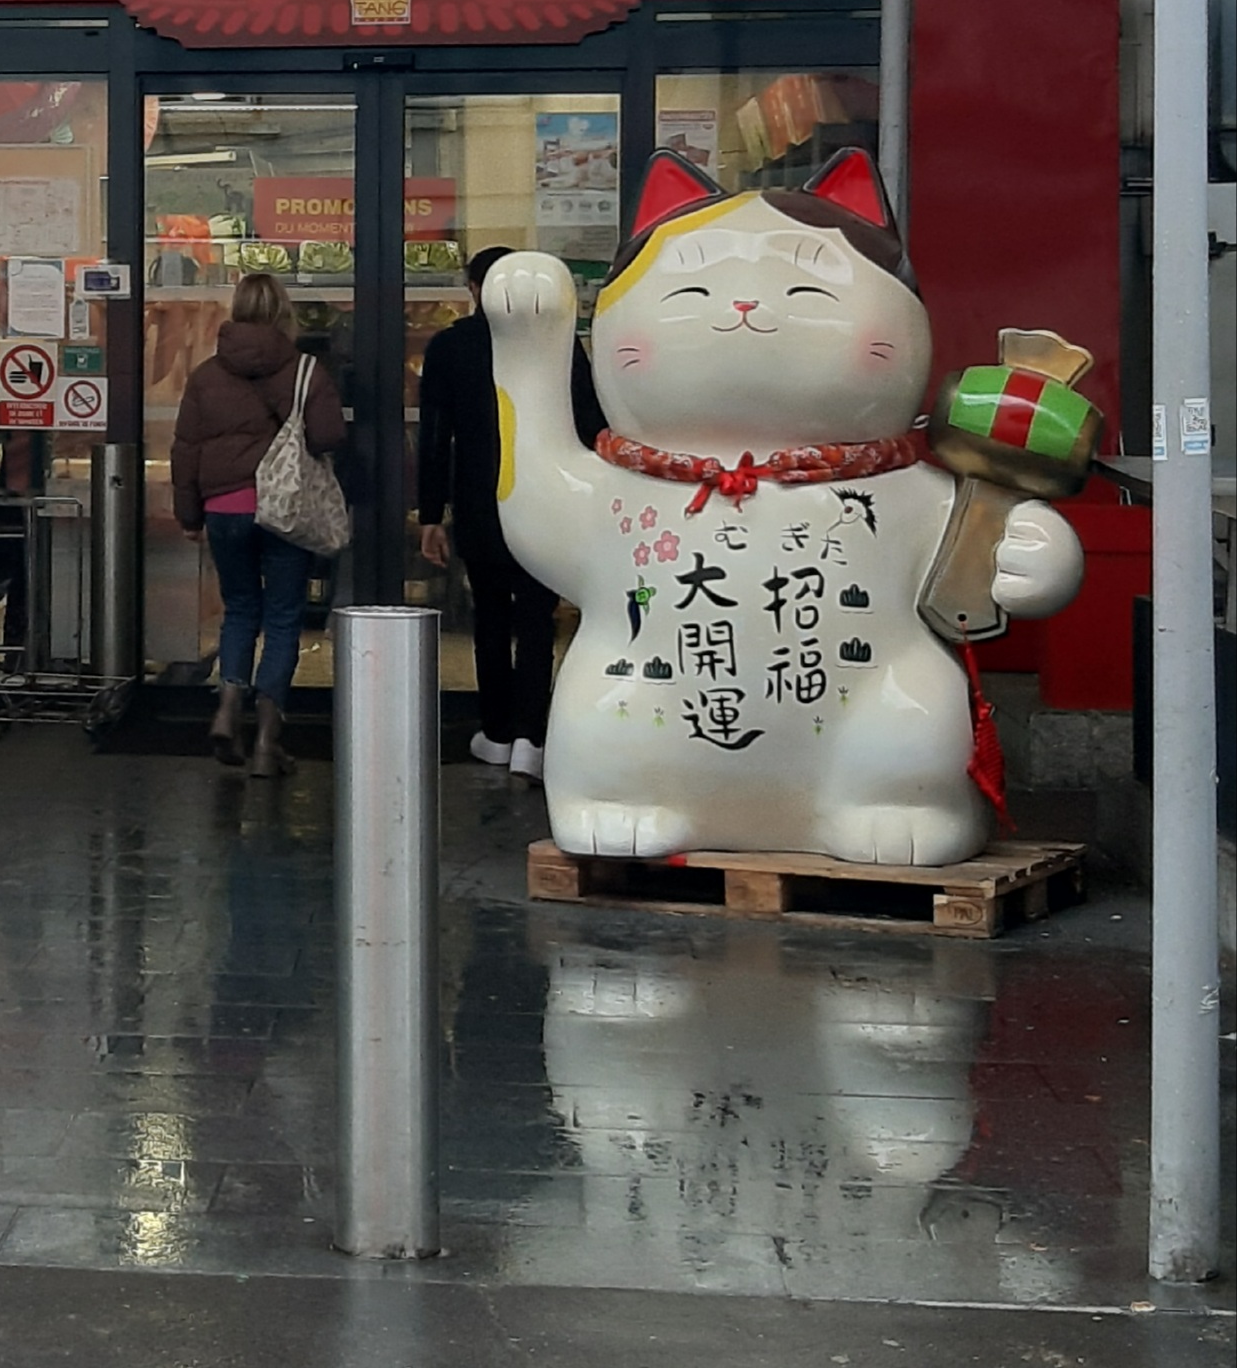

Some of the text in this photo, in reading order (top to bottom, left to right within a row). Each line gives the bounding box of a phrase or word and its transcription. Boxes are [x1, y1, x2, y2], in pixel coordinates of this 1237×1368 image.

[355, 0, 408, 16] TANG
[275, 222, 356, 233] DU MOMENT
[674, 551, 766, 751] 大開運
[762, 565, 827, 705] 招福
